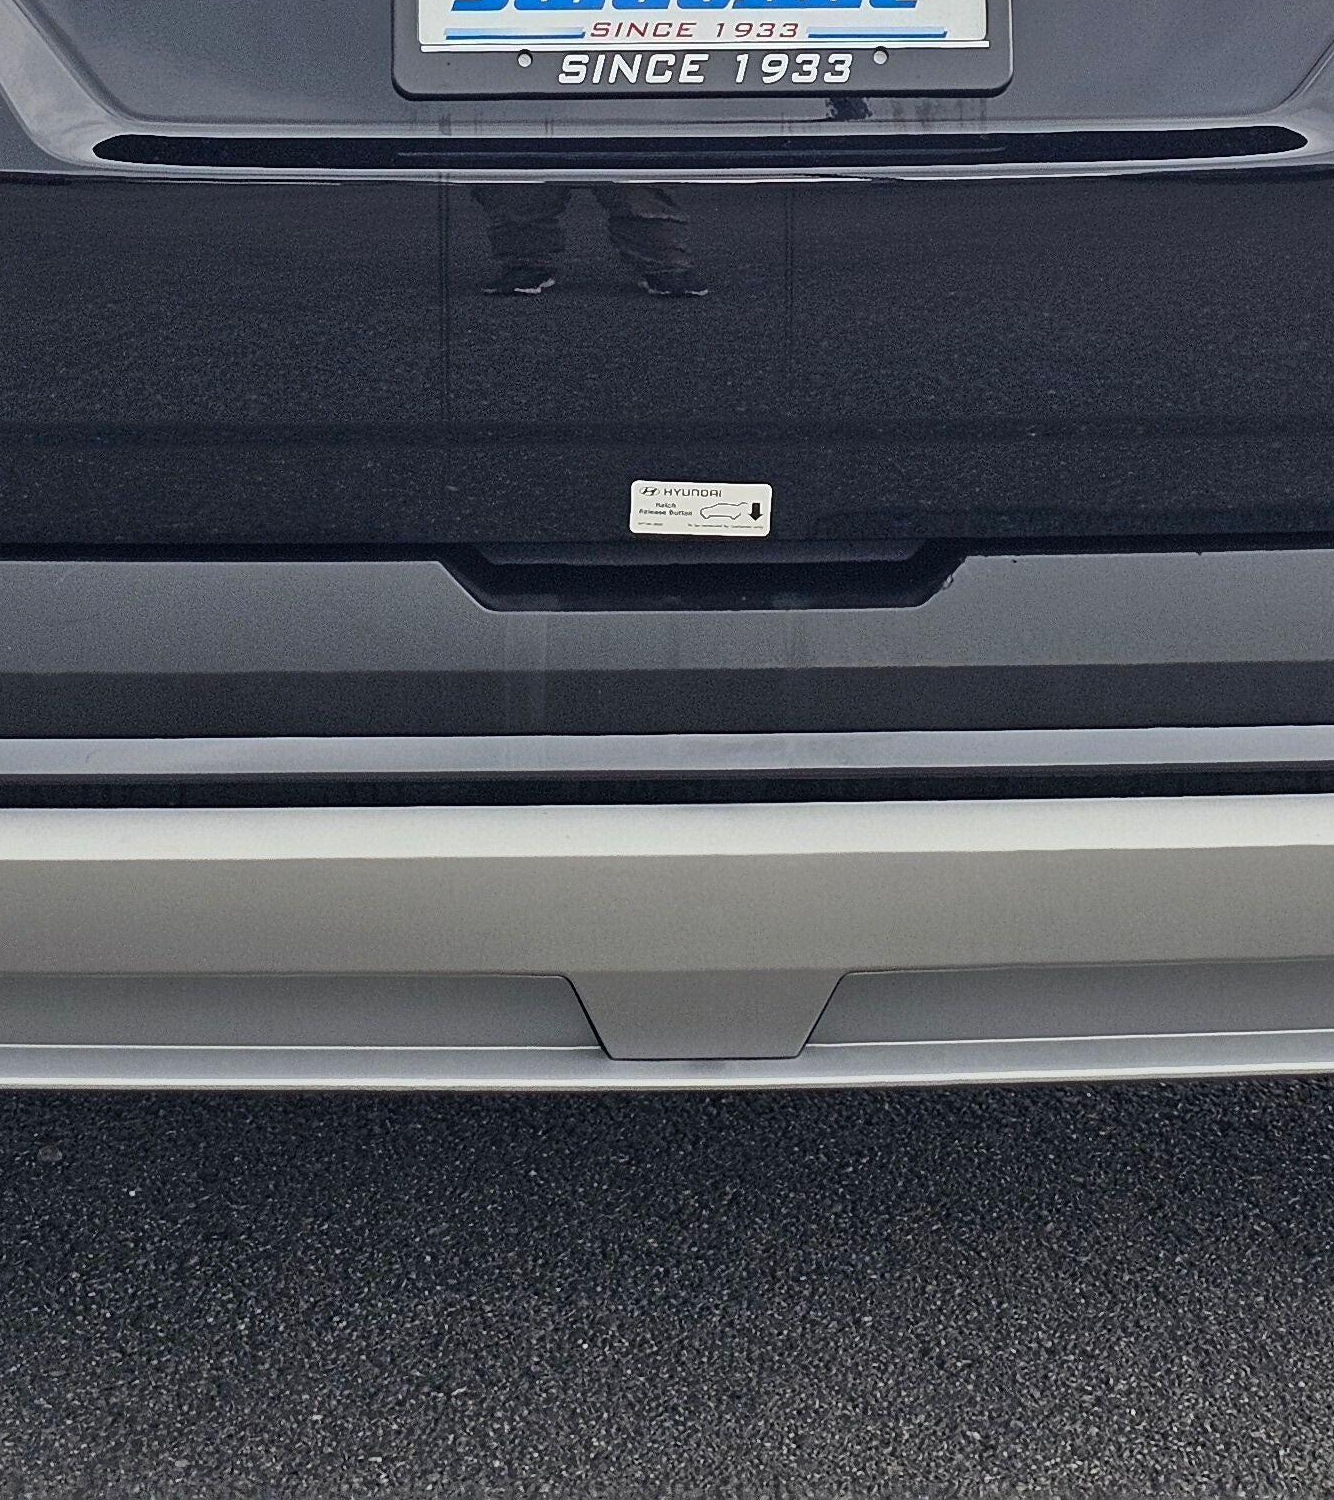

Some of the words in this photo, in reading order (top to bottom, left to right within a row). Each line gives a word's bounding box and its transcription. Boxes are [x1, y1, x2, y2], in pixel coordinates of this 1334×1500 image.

[590, 22, 697, 38] SINCE
[716, 22, 799, 38] 1933
[558, 53, 709, 84] SINCE
[735, 53, 853, 84] 1933
[664, 488, 722, 498] HYUNDAI
